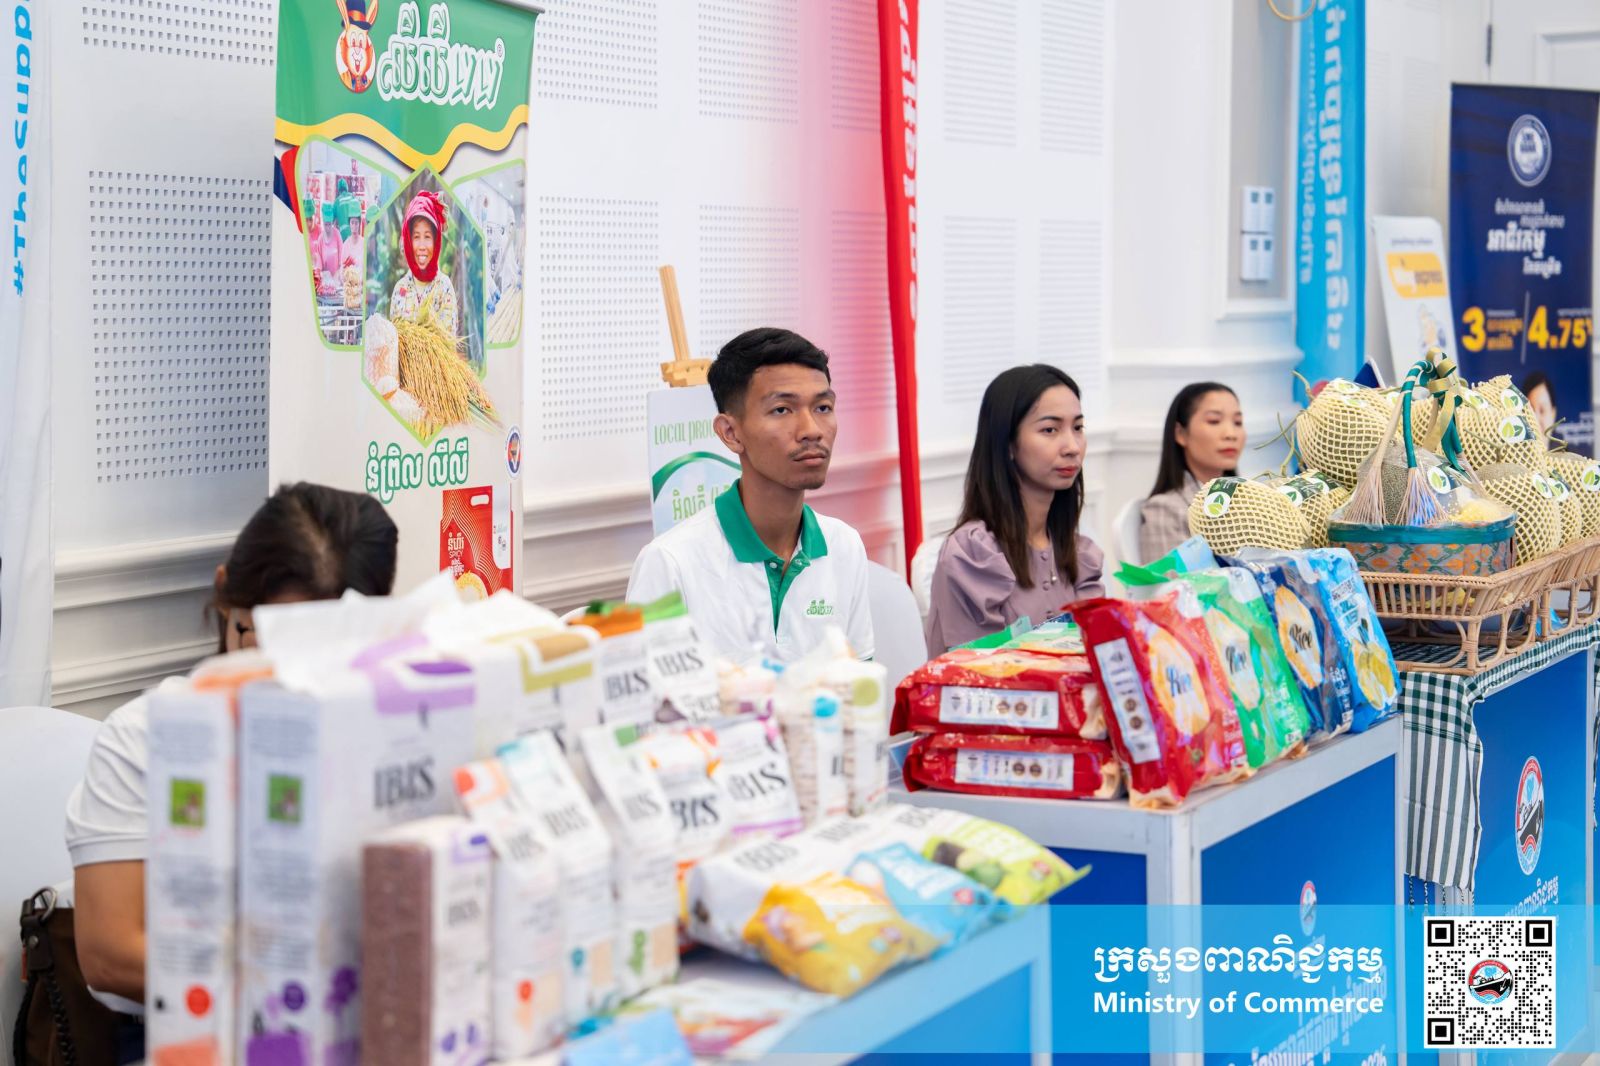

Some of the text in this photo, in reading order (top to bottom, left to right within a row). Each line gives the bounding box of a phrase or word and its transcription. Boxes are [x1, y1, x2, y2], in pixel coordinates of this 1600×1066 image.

[13, 0, 32, 297] #TheSupp
[1462, 306, 1486, 352] 3
[1288, 622, 1314, 654] Rice
[654, 648, 704, 676] IBIS
[374, 757, 436, 810] IBIS
